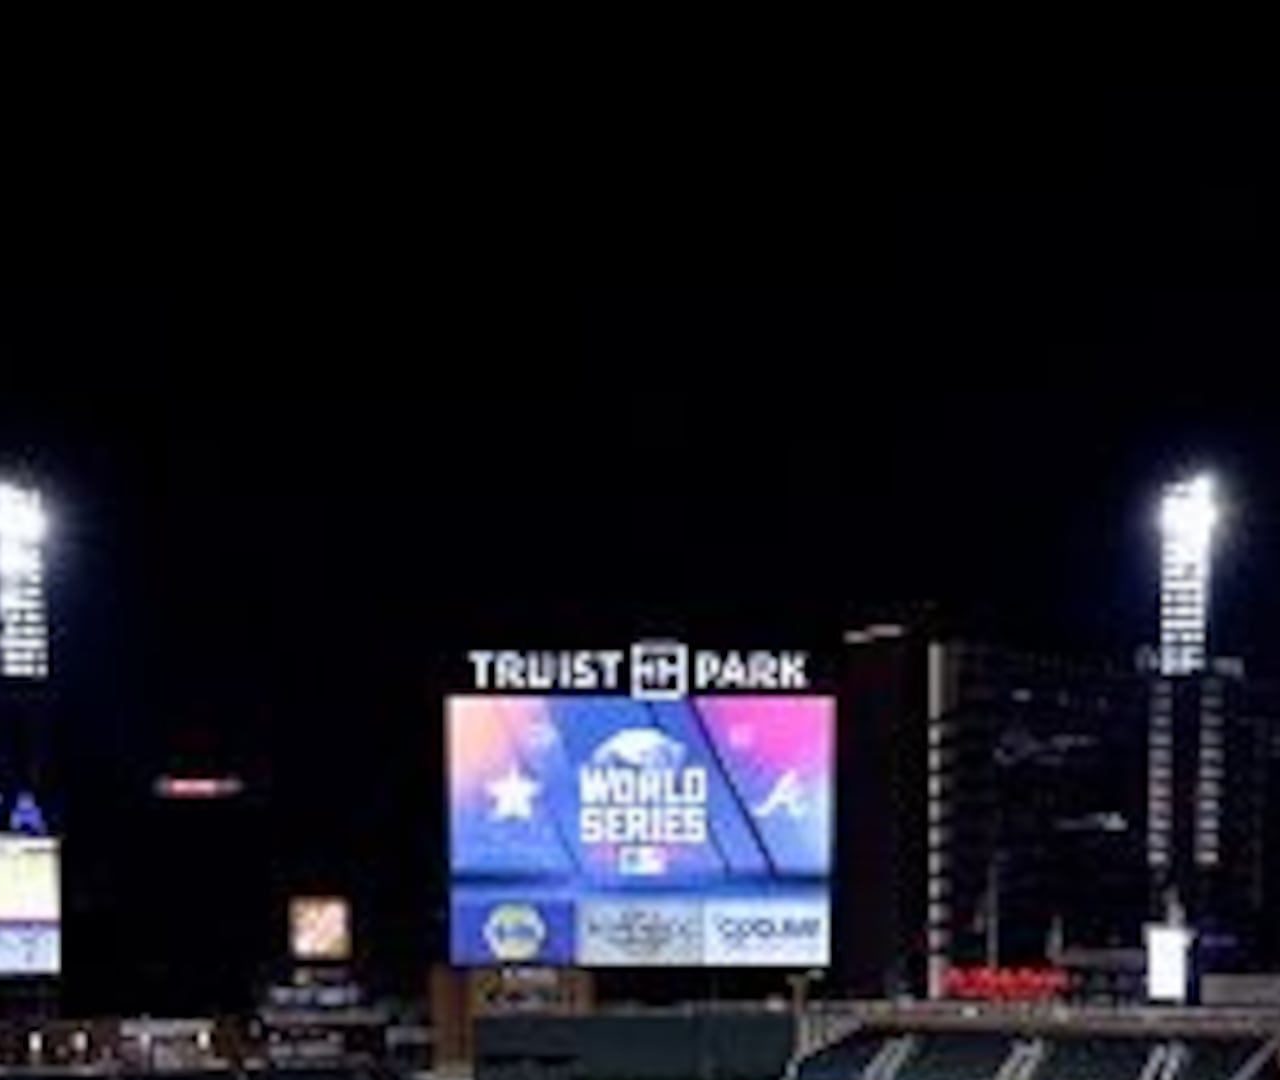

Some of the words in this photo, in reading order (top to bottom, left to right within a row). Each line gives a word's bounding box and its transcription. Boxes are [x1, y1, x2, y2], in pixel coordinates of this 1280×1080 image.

[469, 651, 624, 689] TRUIST
[694, 651, 808, 689] PARK
[580, 767, 707, 804] WORLD
[580, 807, 707, 844] SERIES
